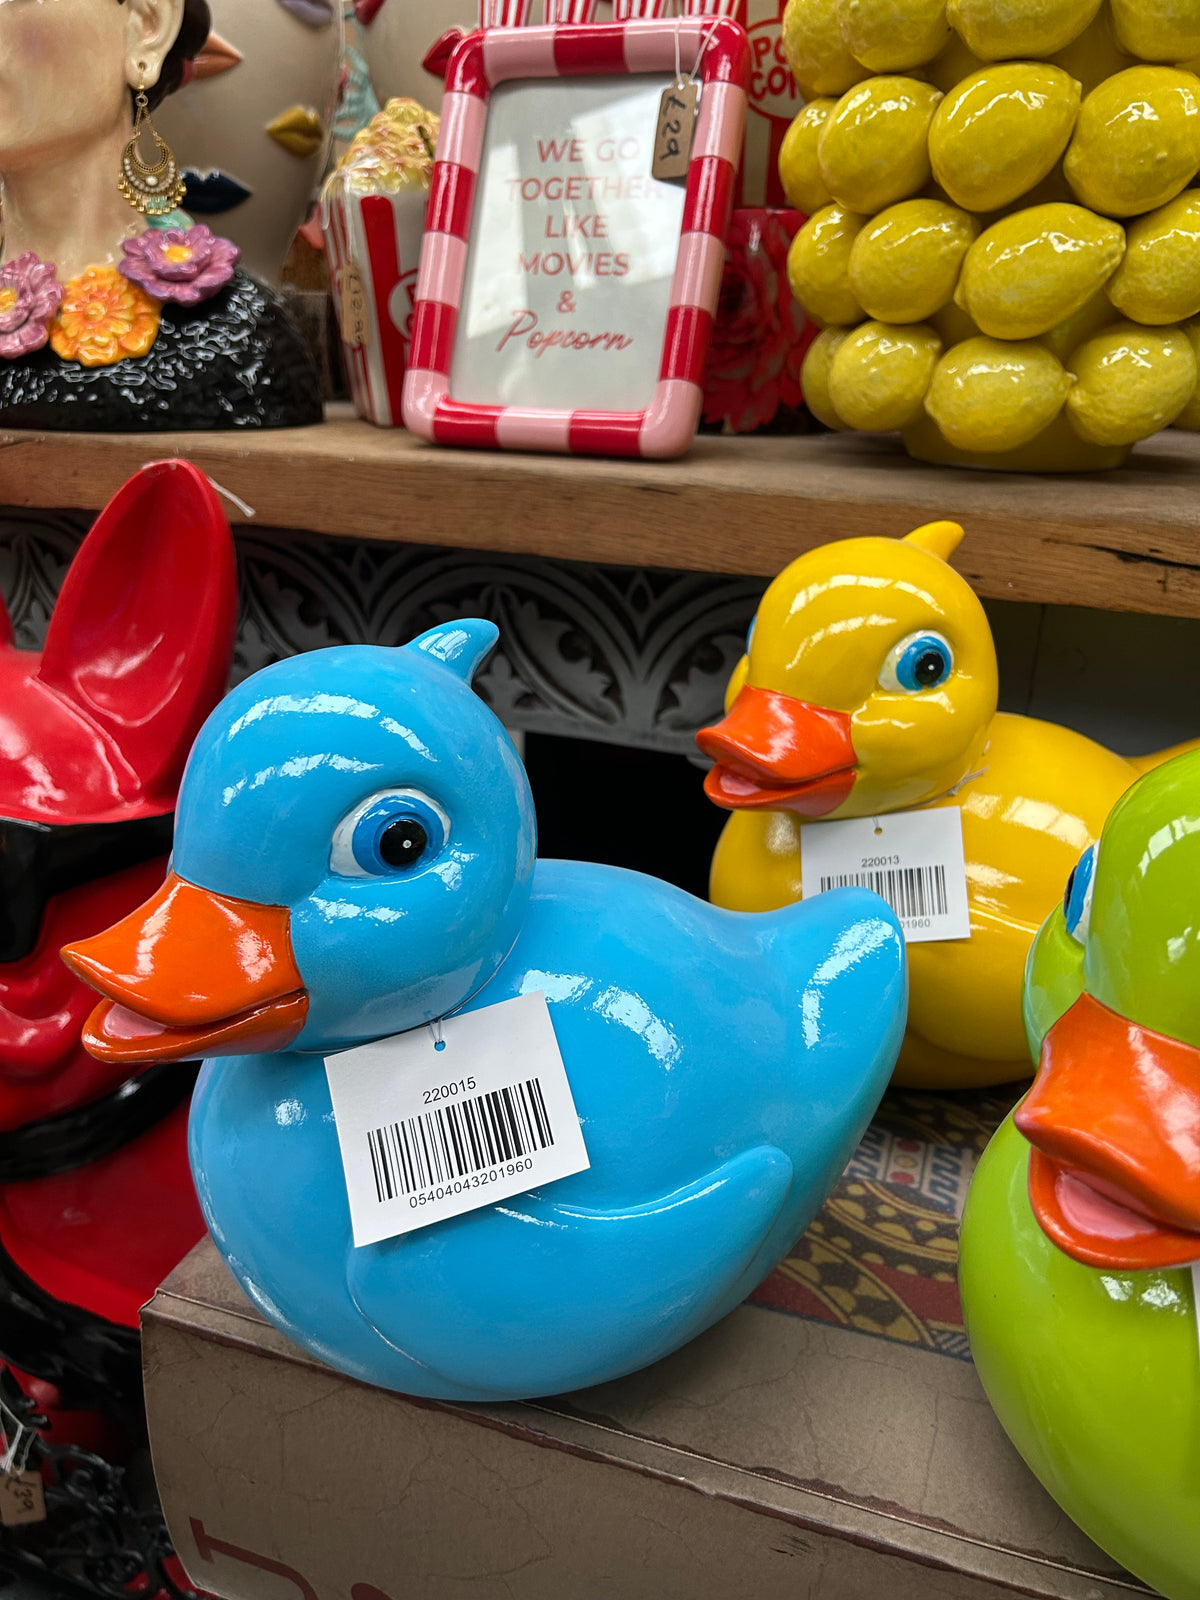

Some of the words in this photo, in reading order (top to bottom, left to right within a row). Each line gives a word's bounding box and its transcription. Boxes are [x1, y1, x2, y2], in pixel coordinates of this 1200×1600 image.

[660, 95, 686, 161] £29
[537, 139, 585, 163] WE
[596, 138, 640, 162] GO
[504, 176, 664, 201] TOGETHER
[545, 214, 609, 238] LIKE
[517, 252, 631, 276] MOVIES
[556, 290, 576, 313] &
[496, 310, 634, 359] Popcorn
[861, 855, 900, 868] 220013
[422, 1076, 477, 1104] 220015
[409, 1158, 533, 1209] 05404043201960
